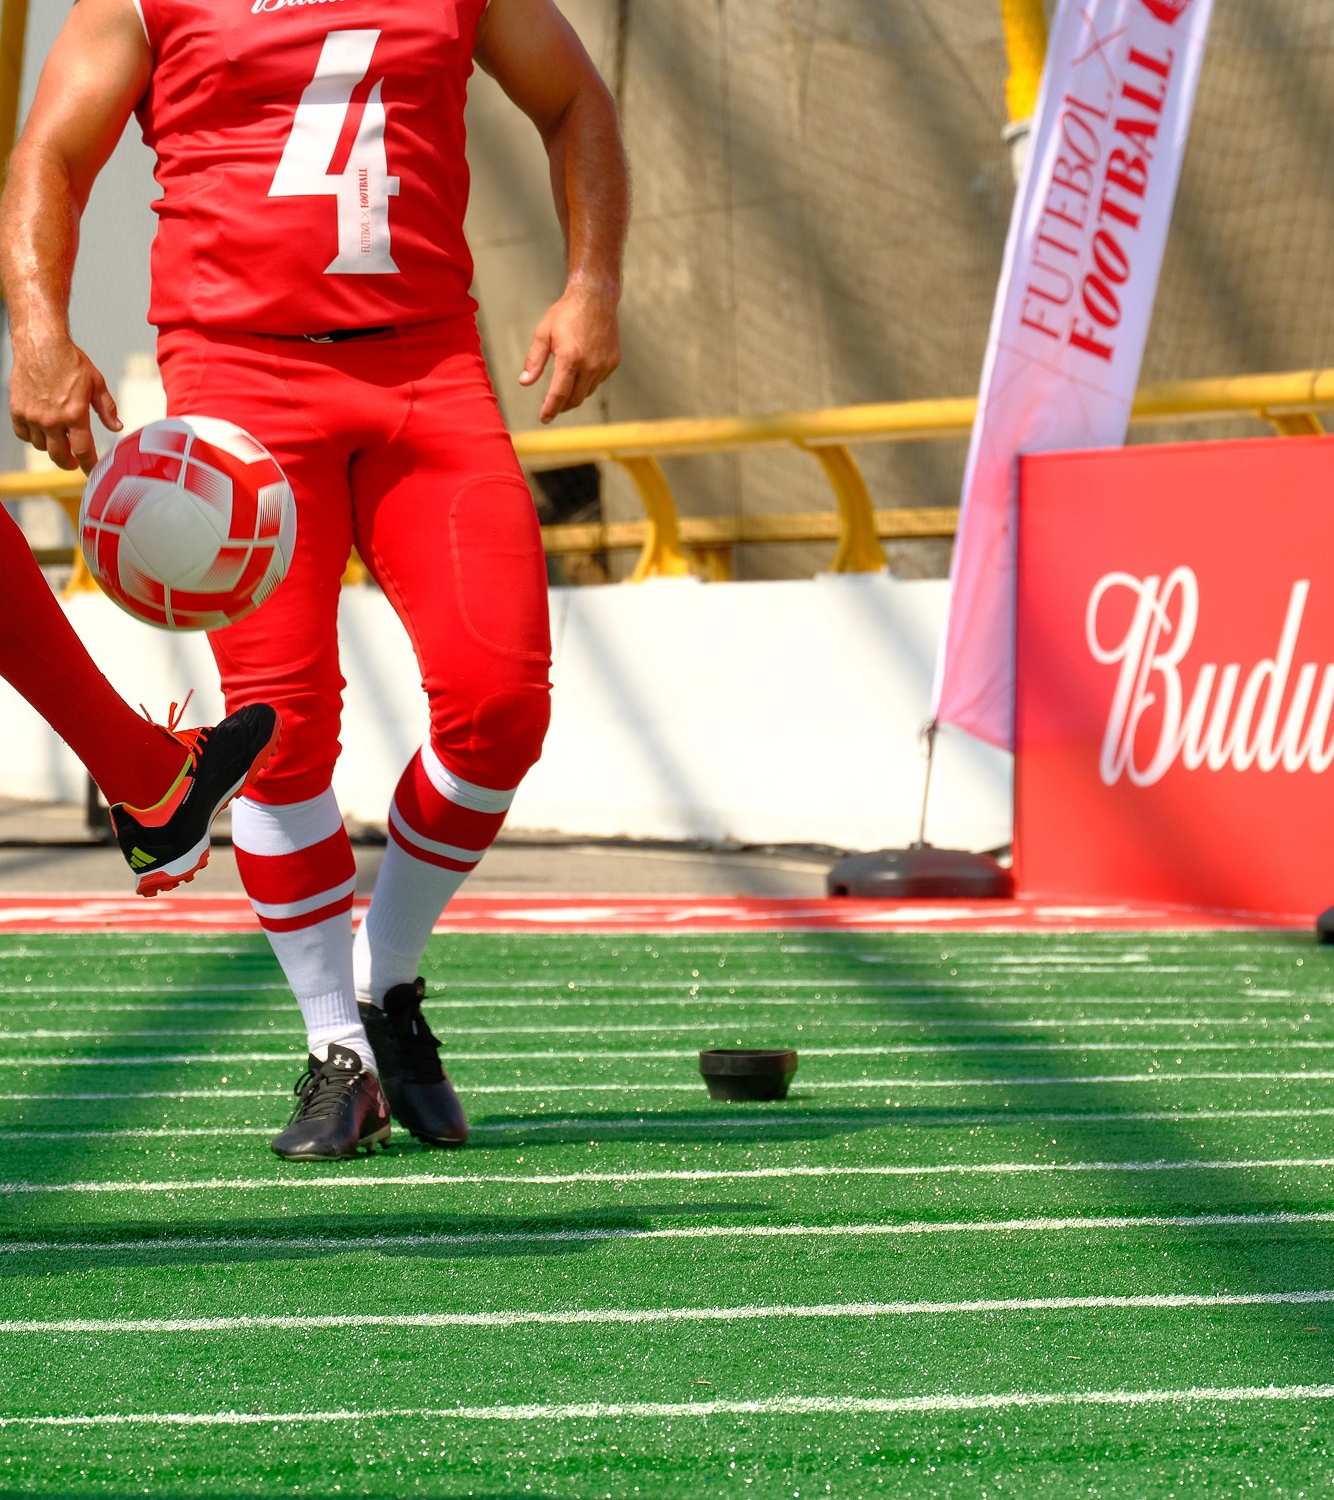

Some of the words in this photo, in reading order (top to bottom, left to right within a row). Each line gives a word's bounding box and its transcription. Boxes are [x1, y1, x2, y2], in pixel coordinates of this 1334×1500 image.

[267, 28, 401, 275] 4
[358, 166, 369, 209] FOOTBALL
[1020, 90, 1114, 343] FUTEBOL
[1068, 46, 1175, 364] FOOTBALL
